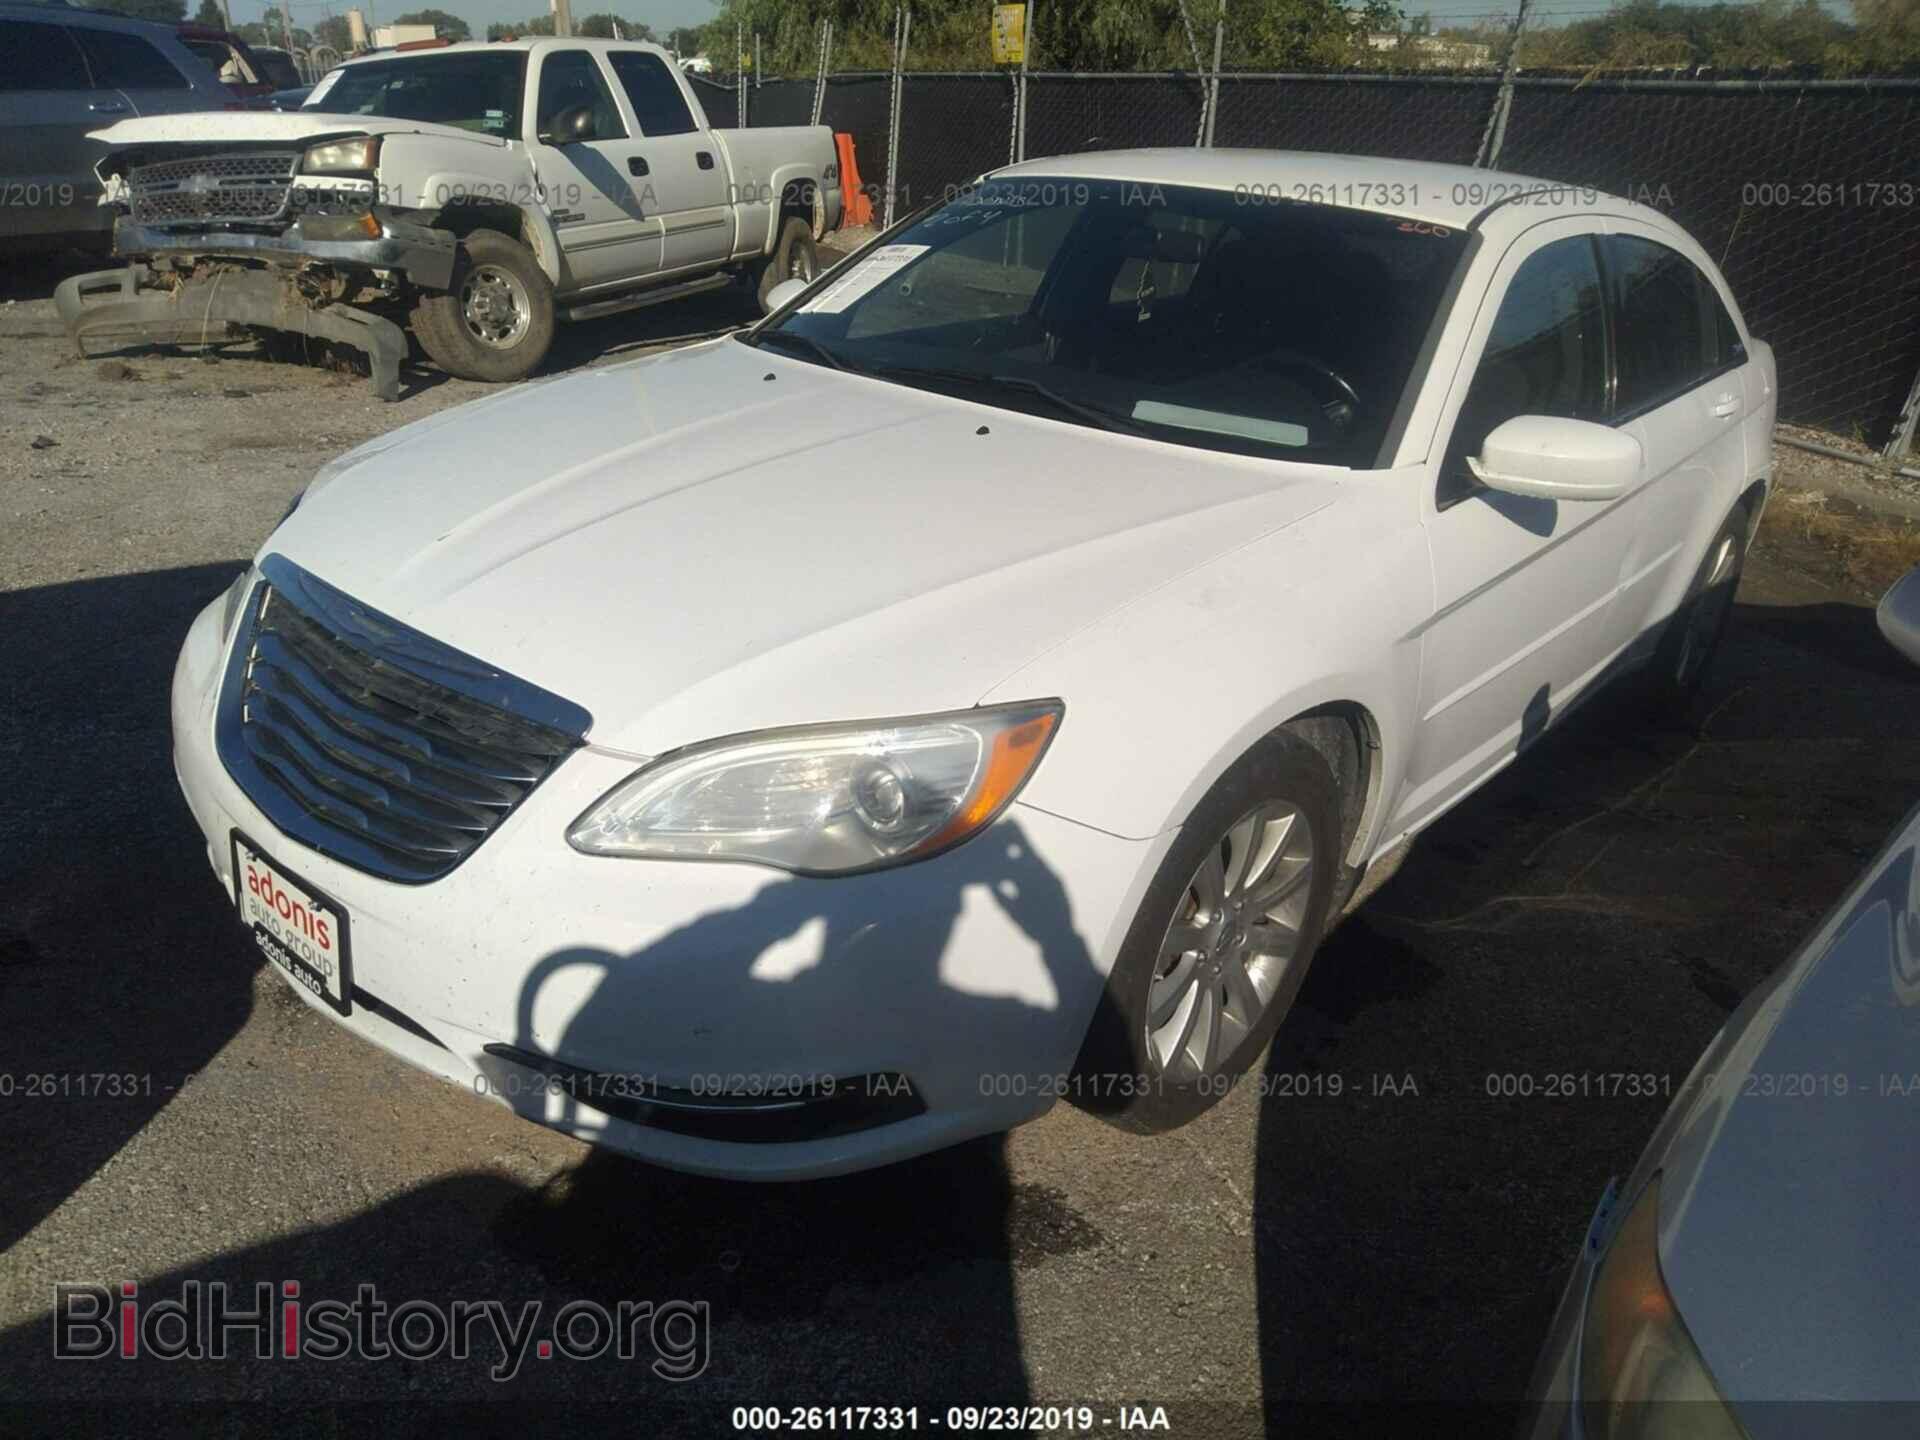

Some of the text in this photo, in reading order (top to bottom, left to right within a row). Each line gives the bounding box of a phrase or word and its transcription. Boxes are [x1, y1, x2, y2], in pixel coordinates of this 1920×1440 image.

[247, 864, 331, 950] adonis
[250, 898, 334, 977] auto group
[255, 930, 323, 995] adonis auto
